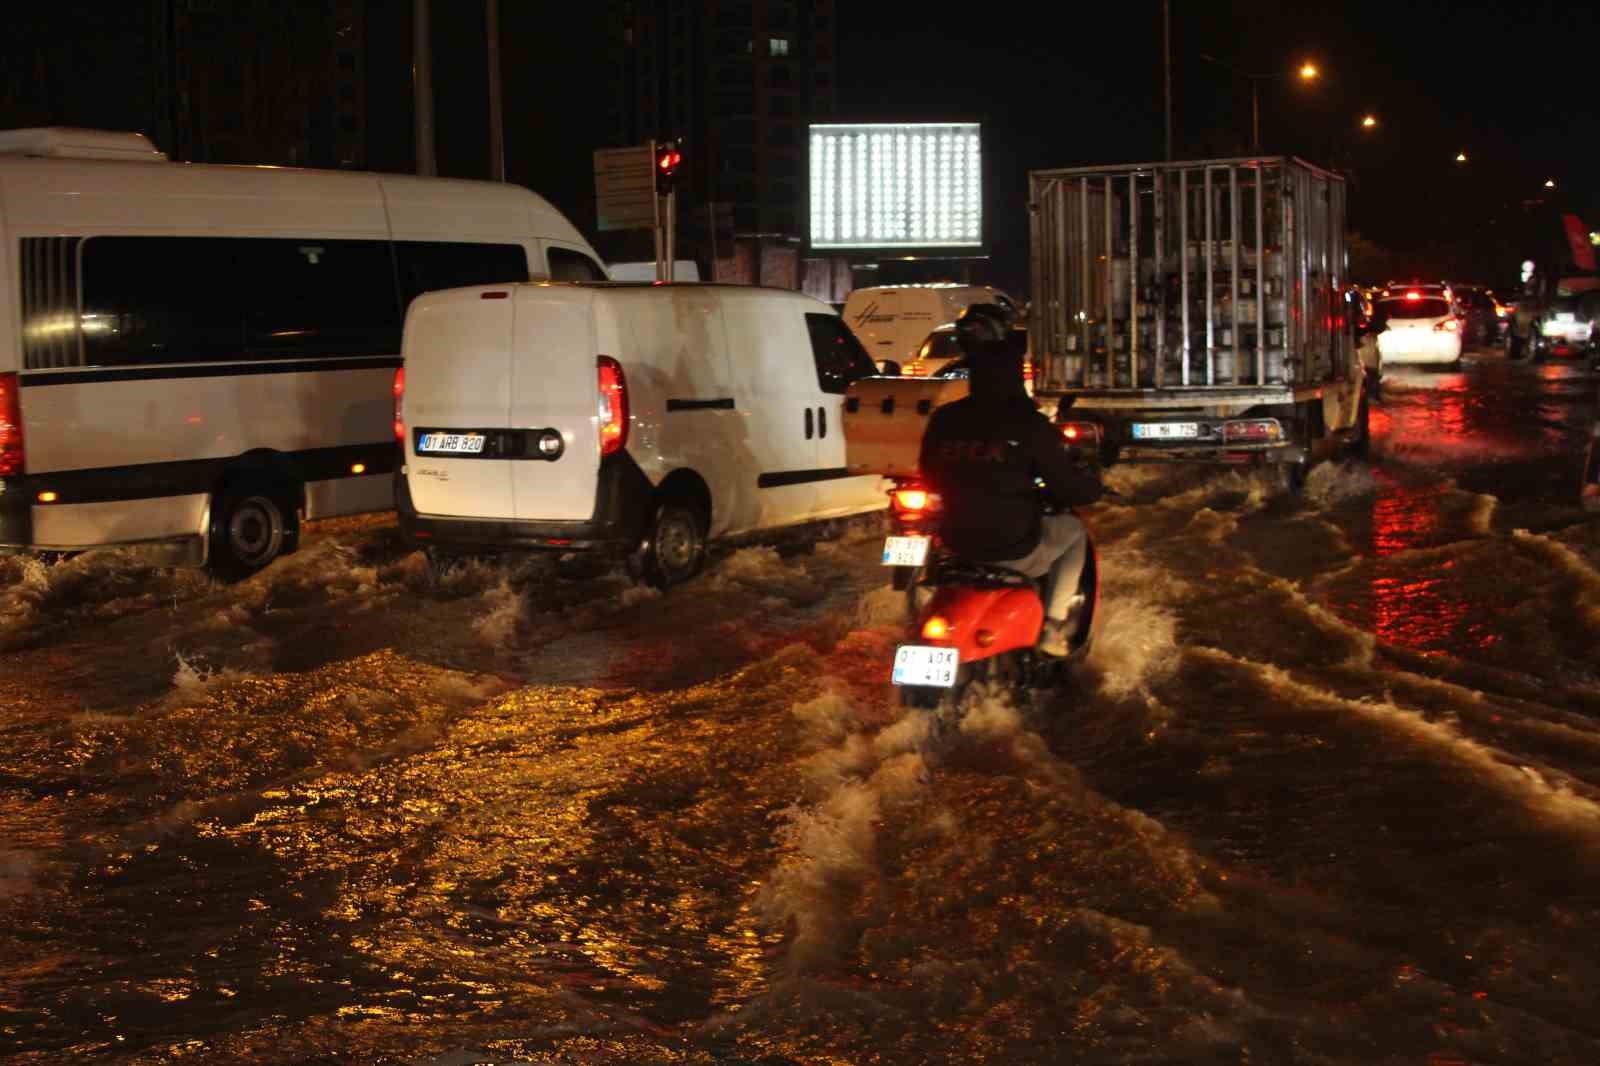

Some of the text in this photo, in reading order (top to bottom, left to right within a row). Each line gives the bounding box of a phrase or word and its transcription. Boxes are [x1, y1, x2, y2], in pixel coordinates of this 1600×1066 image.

[424, 436, 482, 451] 01 ARB 820
